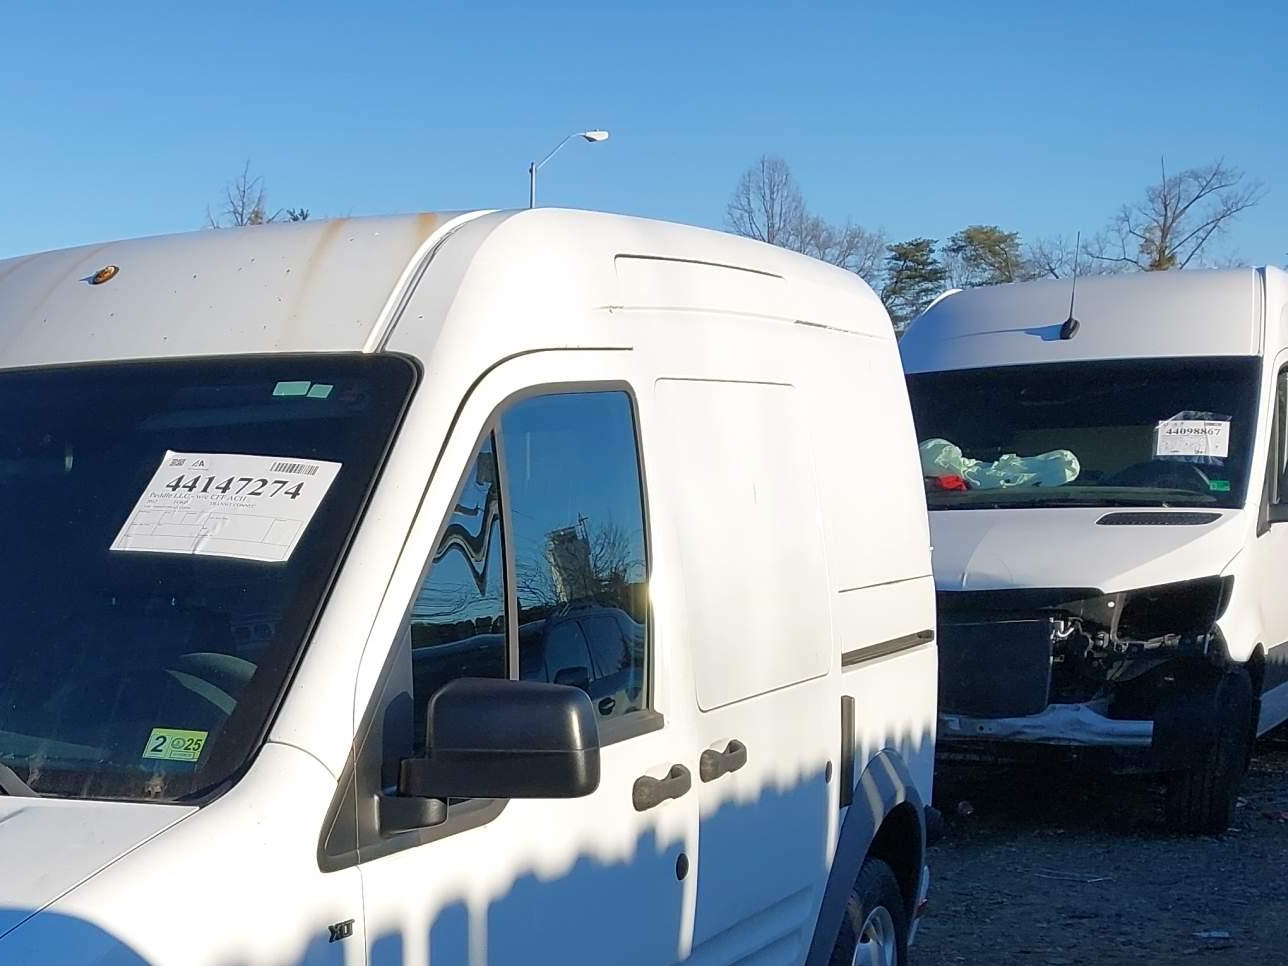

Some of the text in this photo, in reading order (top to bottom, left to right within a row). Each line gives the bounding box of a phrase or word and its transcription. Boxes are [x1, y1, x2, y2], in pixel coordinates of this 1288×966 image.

[1165, 428, 1221, 436] 44098867
[166, 474, 305, 499] 44147274
[151, 735, 203, 752] 2 25
[328, 918, 355, 943] XLT
